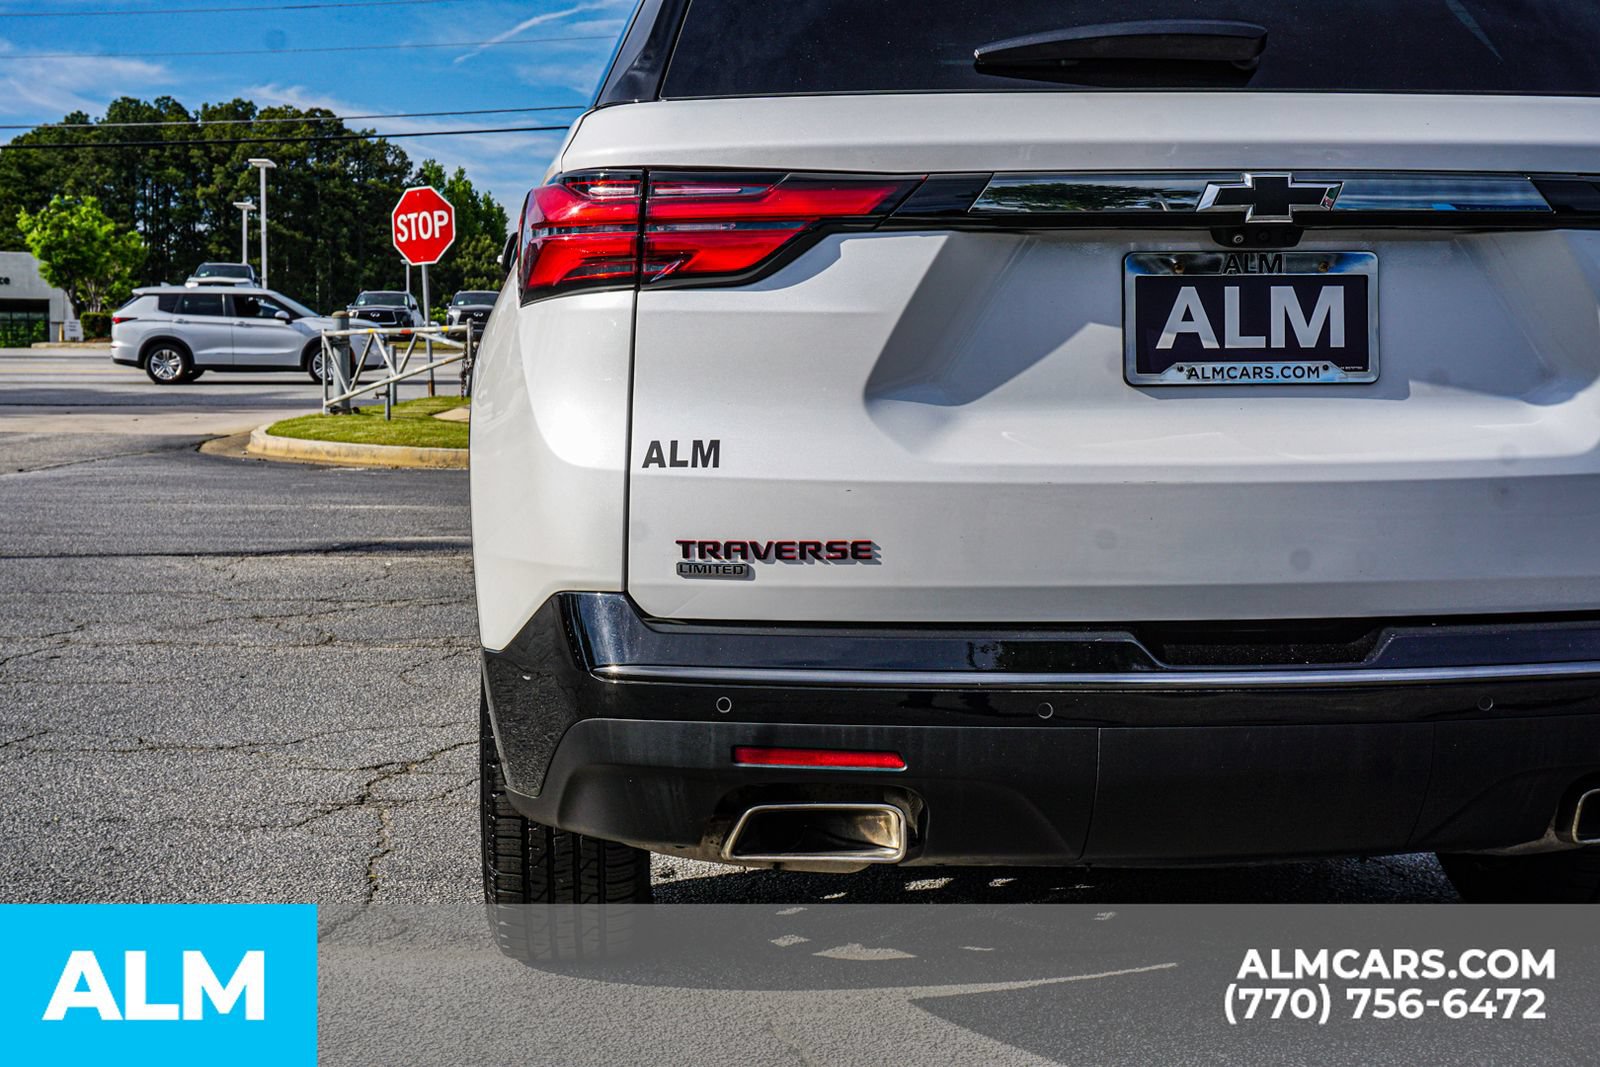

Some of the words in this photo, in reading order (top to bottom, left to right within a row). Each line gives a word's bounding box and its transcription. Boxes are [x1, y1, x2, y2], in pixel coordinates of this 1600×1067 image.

[396, 210, 449, 243] STOP
[1222, 253, 1283, 275] ALM
[1155, 285, 1346, 350] ALM
[1187, 365, 1320, 380] ALMCARS.COM
[641, 439, 721, 469] ALM
[675, 539, 873, 560] TRAVERSE
[678, 563, 745, 576] LIMITED
